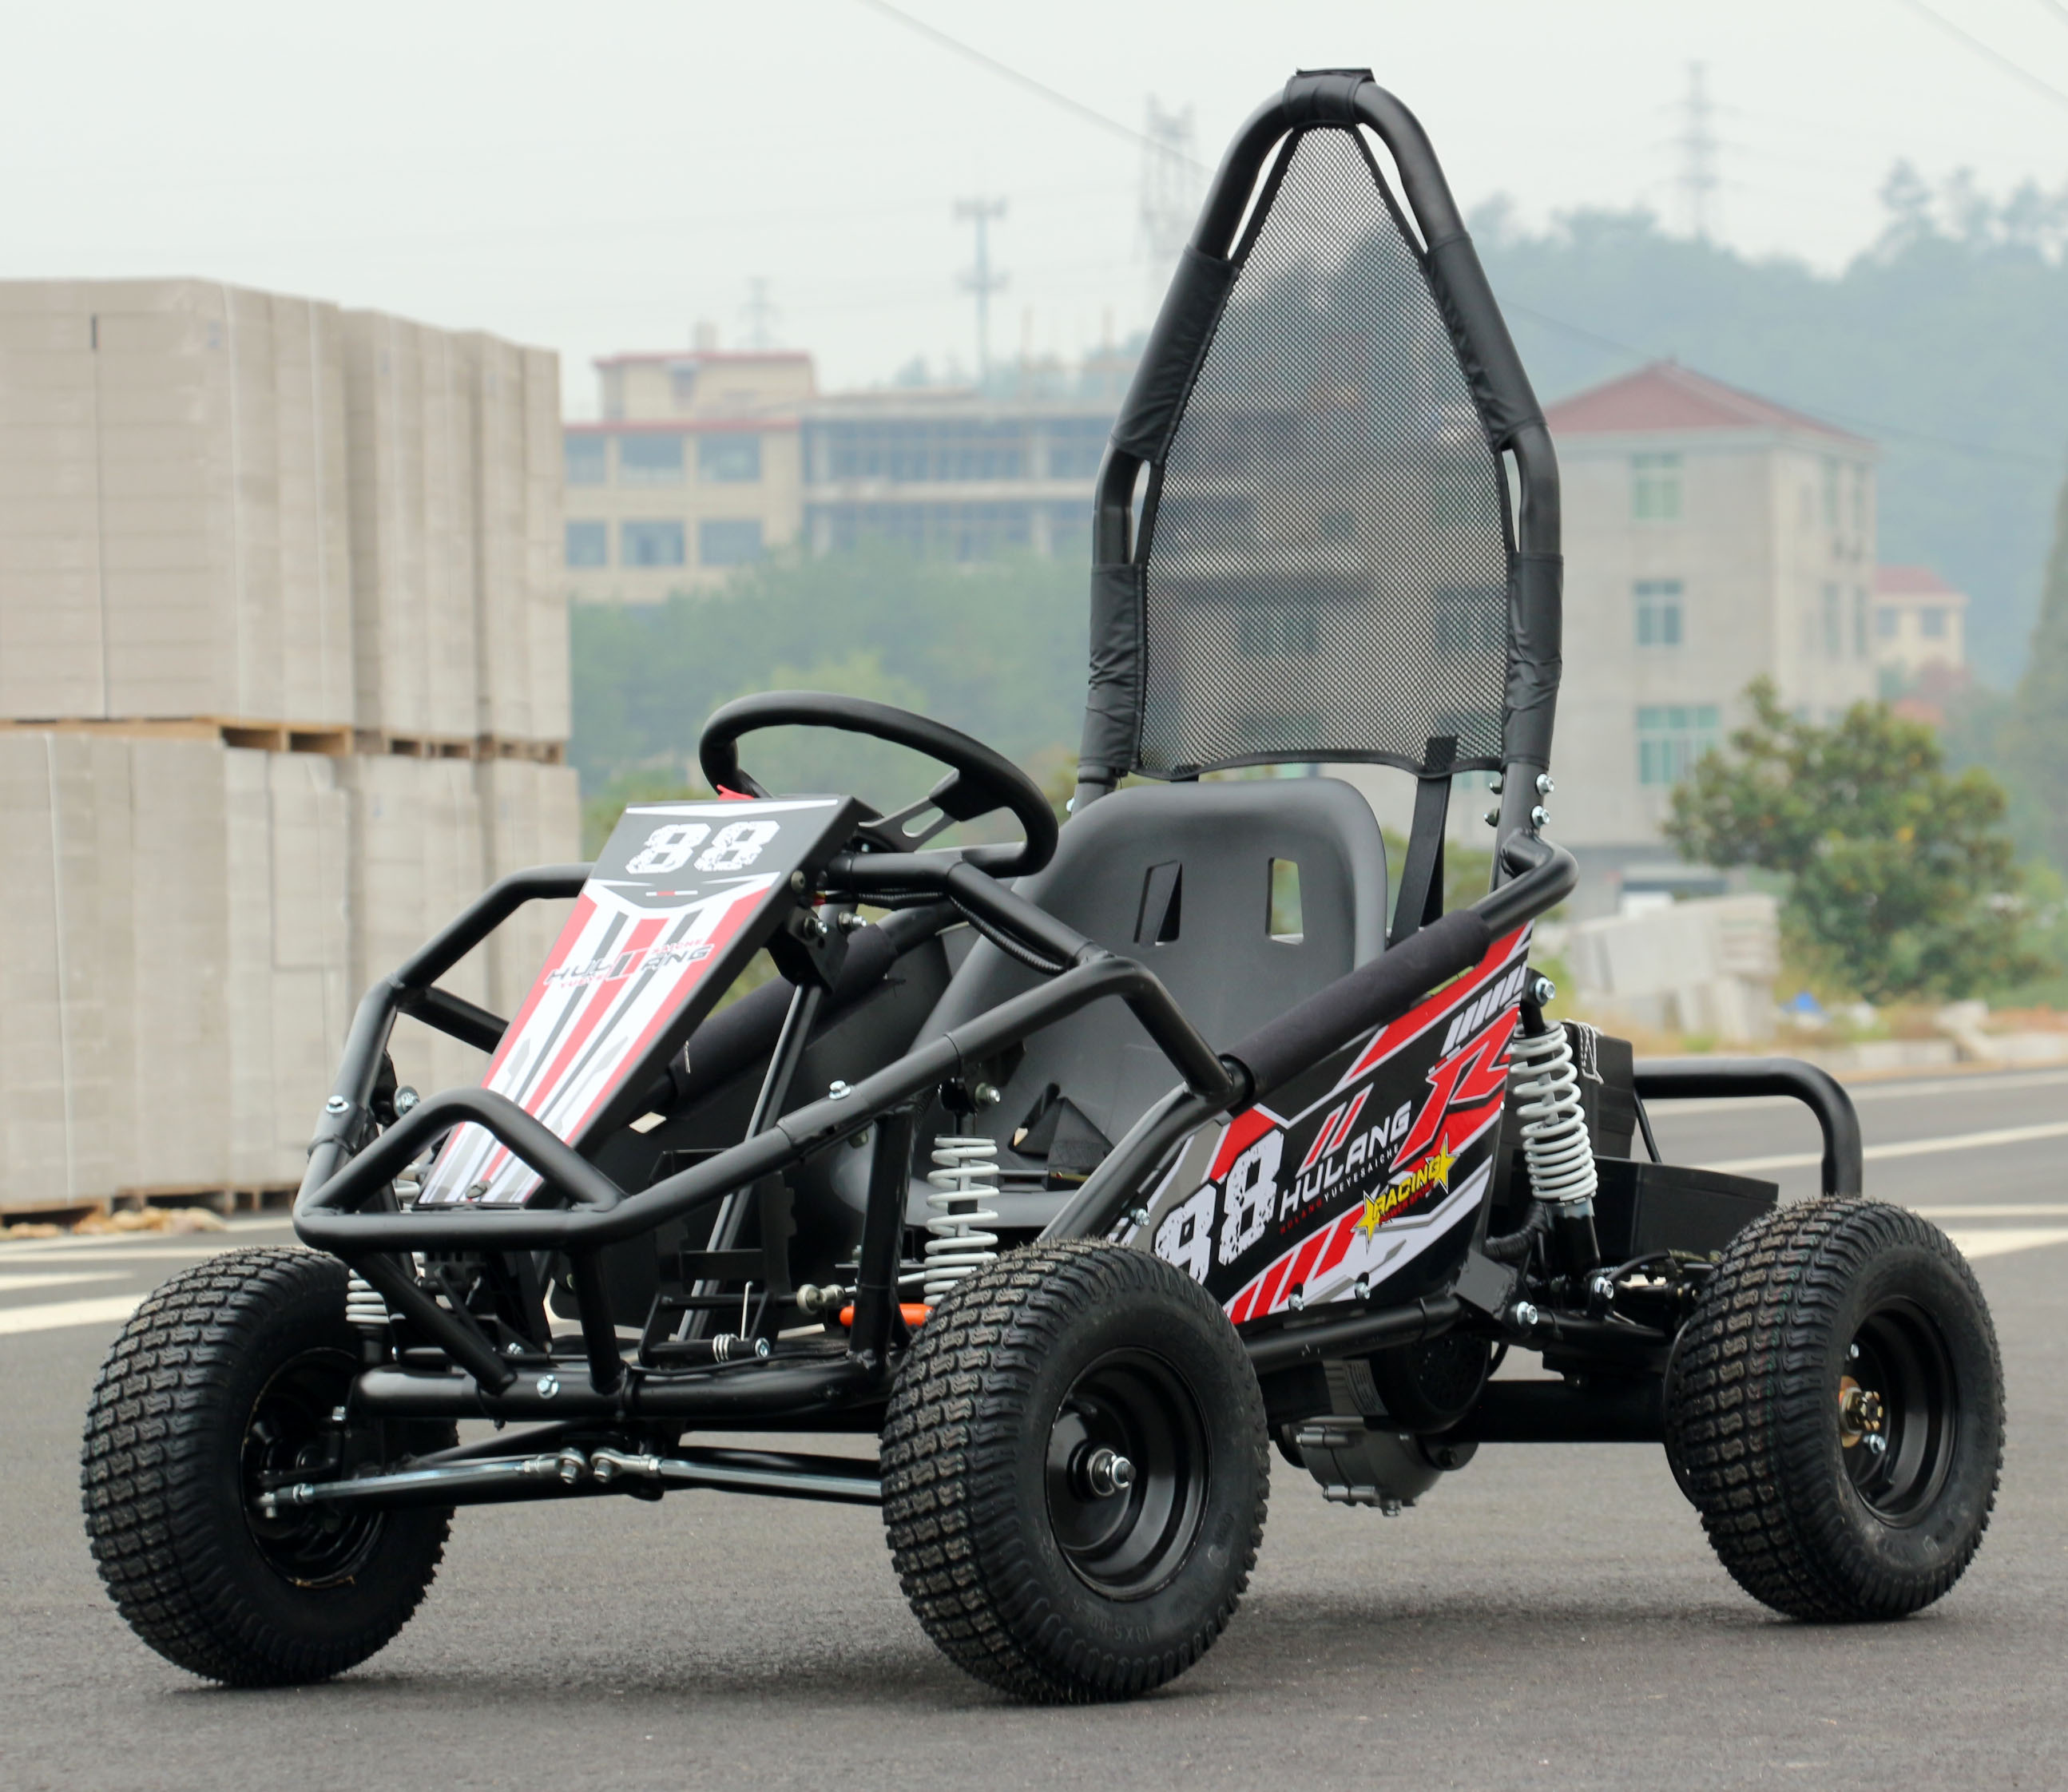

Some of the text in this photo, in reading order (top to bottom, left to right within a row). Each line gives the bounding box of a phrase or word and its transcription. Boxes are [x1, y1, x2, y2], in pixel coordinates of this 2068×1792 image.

[625, 820, 780, 874] 88
[1280, 1099, 1412, 1223] HULANG
[1373, 1154, 1442, 1225] RACING
